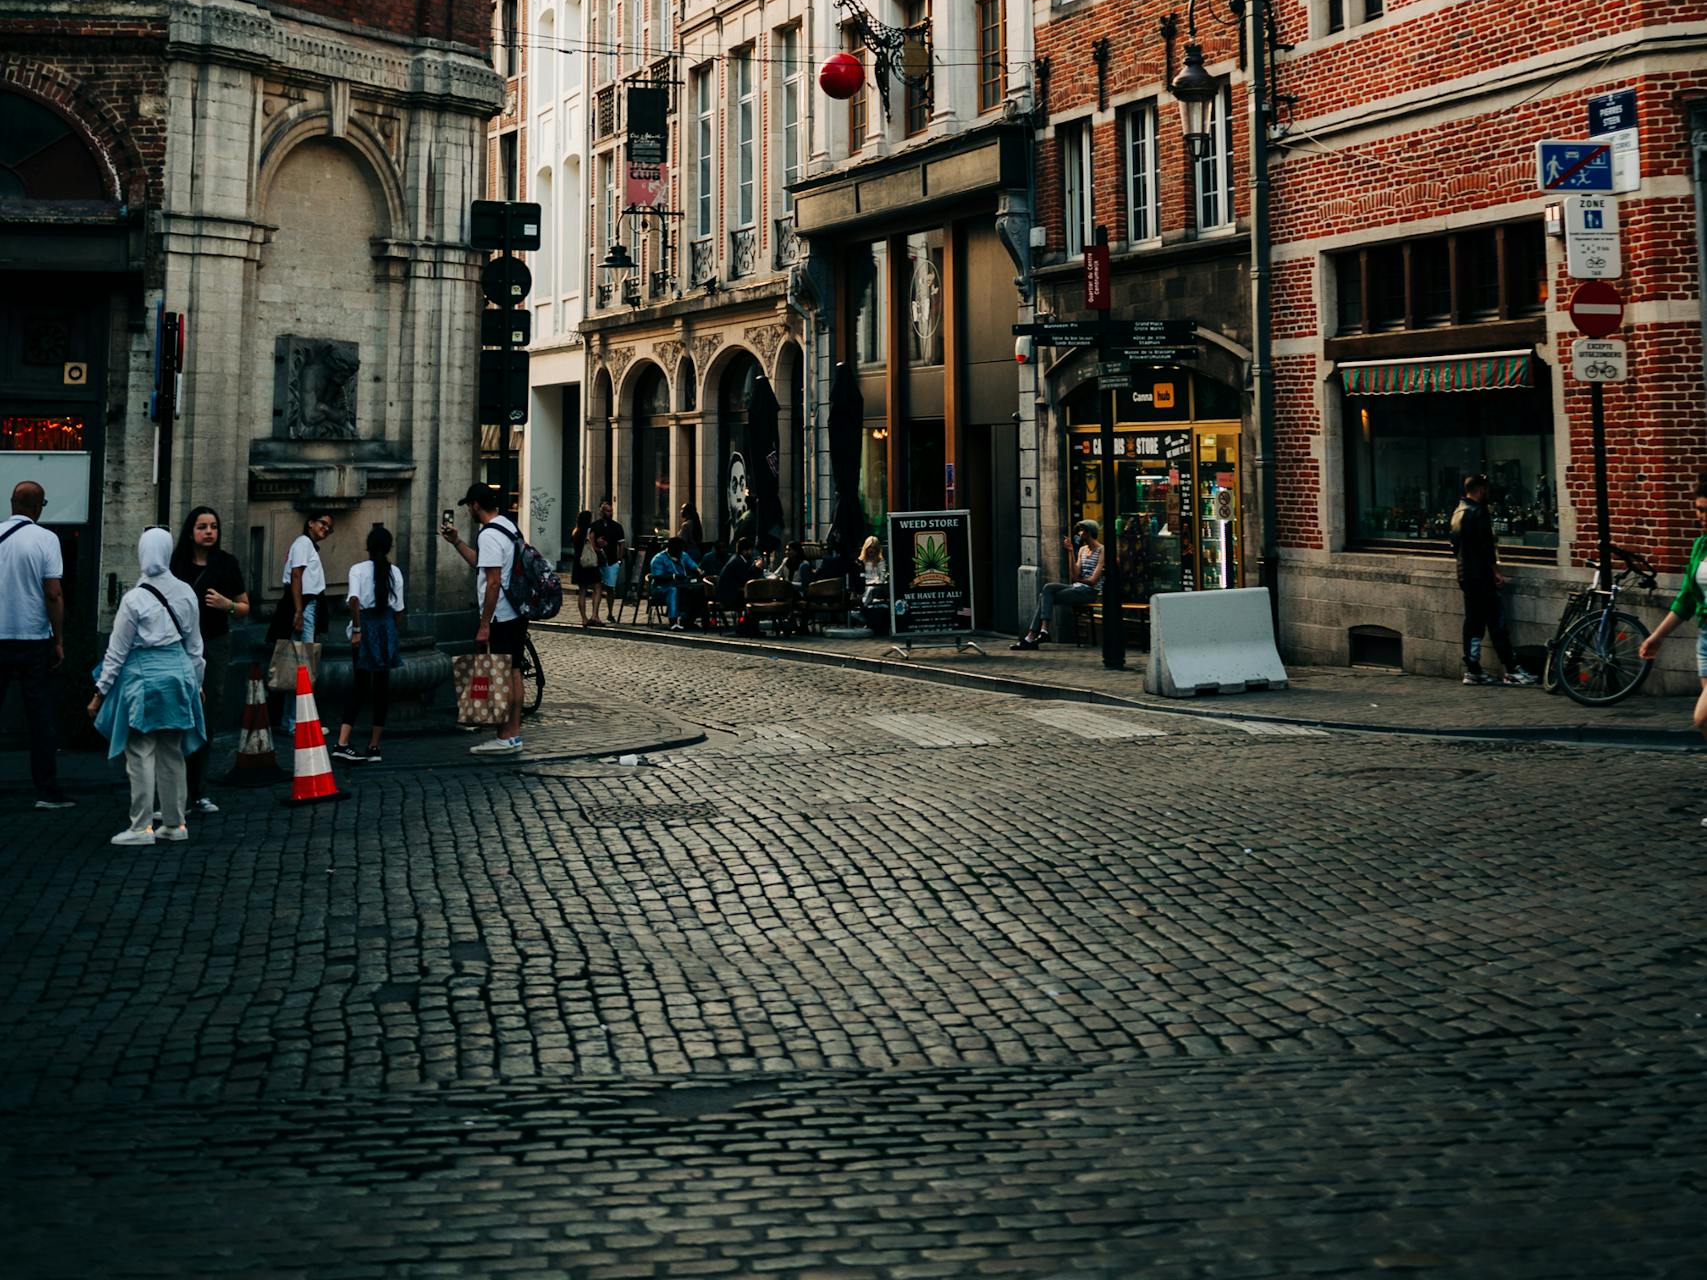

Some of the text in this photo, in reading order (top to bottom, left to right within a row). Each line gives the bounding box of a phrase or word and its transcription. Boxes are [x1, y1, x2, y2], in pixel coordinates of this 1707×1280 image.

[630, 171, 661, 180] CLUB
[1580, 200, 1605, 208] ZONE
[1133, 390, 1170, 402] Canna hub
[1093, 438, 1126, 455] CABIS
[1136, 437, 1159, 455] STORE
[900, 519, 960, 529] WEED STORE
